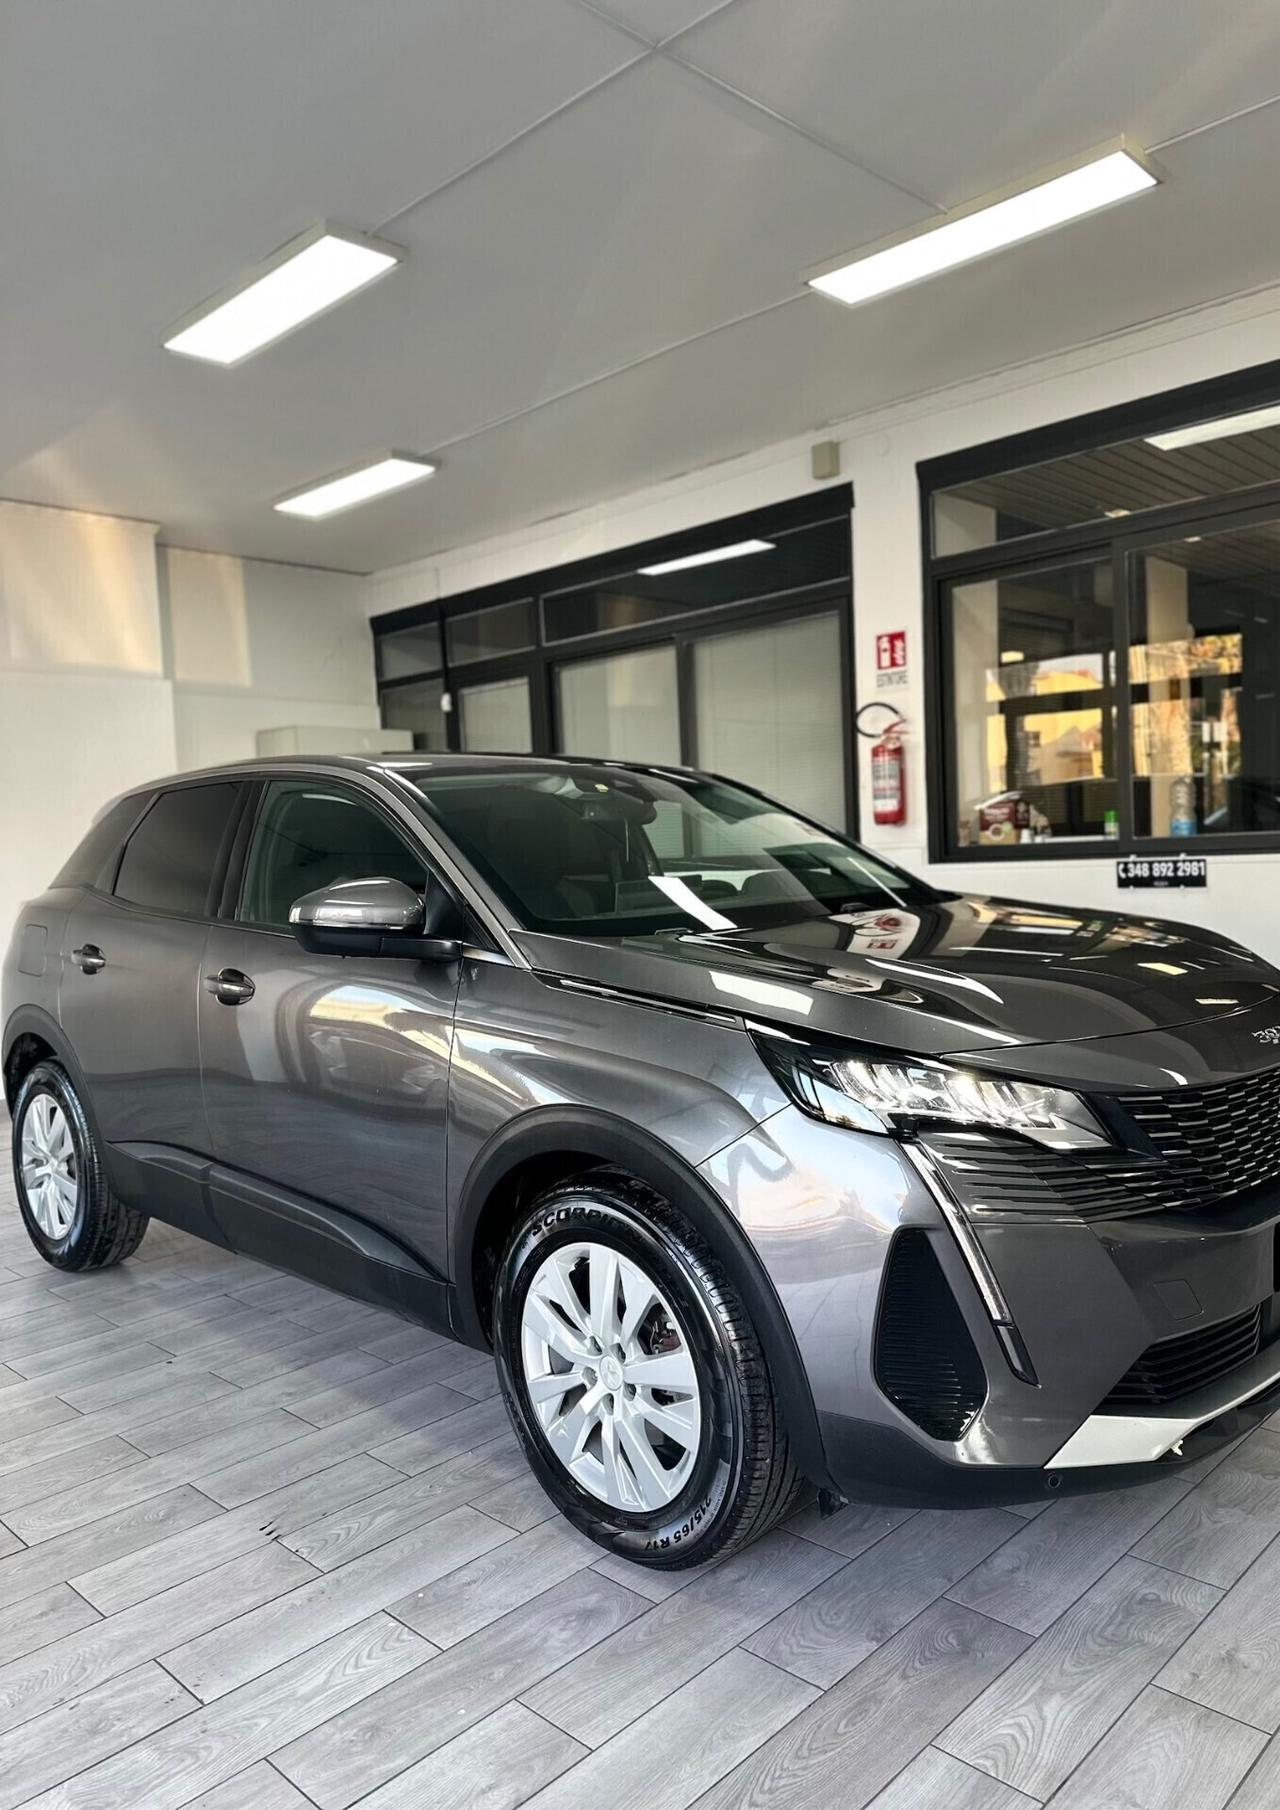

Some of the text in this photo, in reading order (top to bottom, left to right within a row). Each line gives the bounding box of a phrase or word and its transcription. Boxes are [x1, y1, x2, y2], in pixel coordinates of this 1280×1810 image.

[1127, 861, 1205, 878] 348 892 2981
[674, 1494, 712, 1543] 215/65
[644, 1537, 670, 1551] R17
